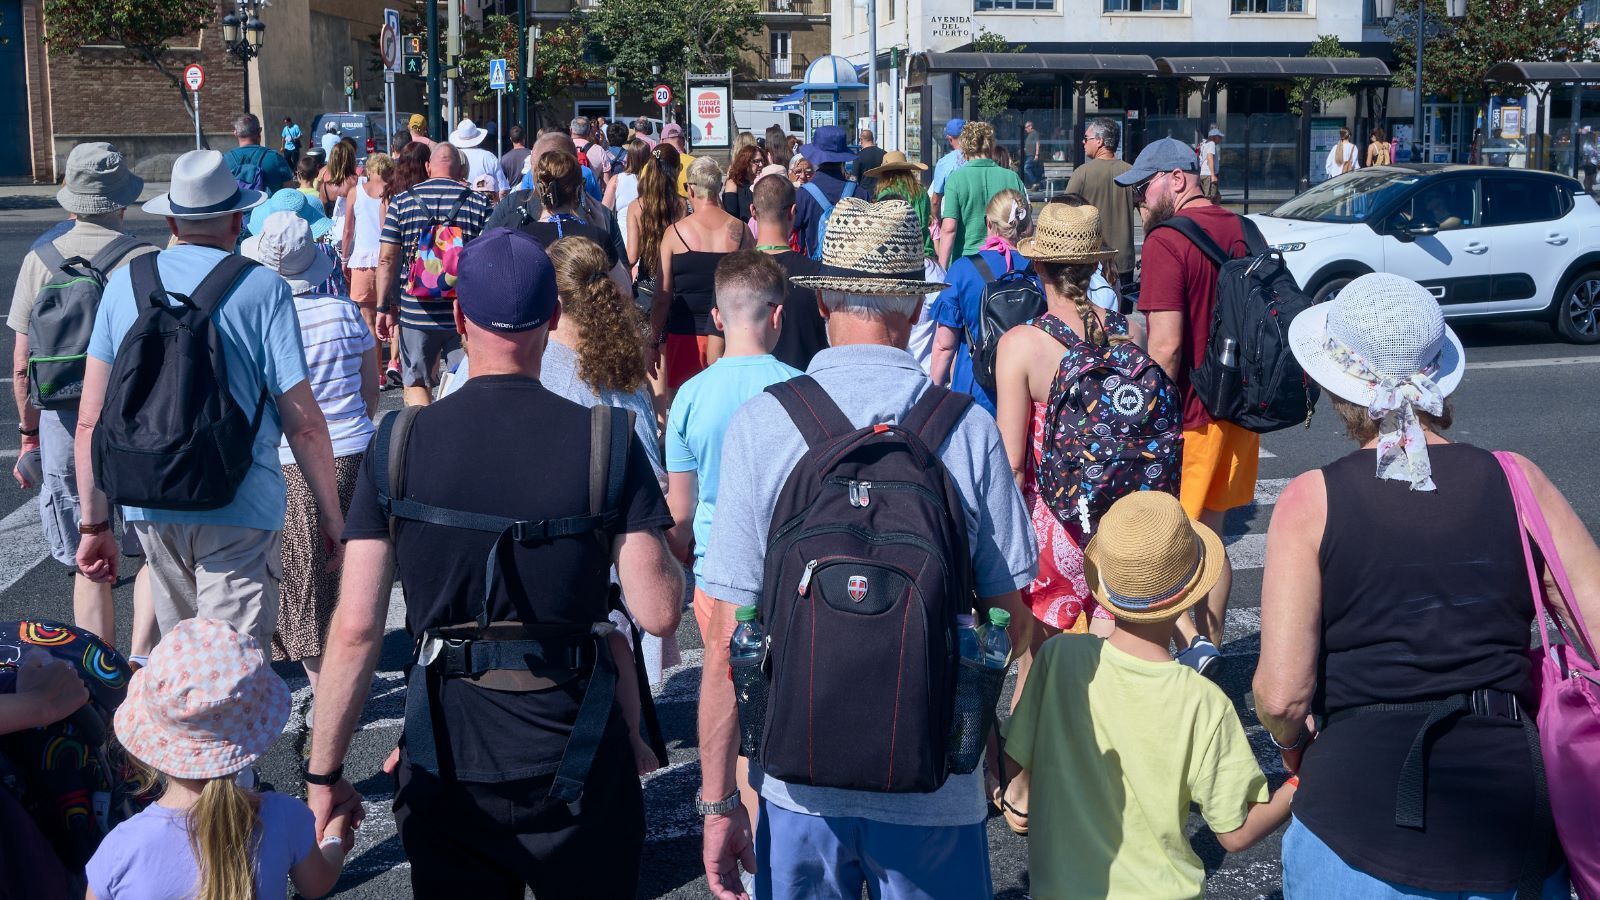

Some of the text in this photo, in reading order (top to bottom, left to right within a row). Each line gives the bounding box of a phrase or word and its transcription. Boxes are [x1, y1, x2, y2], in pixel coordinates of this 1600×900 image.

[411, 37, 420, 53] 9
[657, 90, 668, 100] 20
[697, 106, 721, 114] KING
